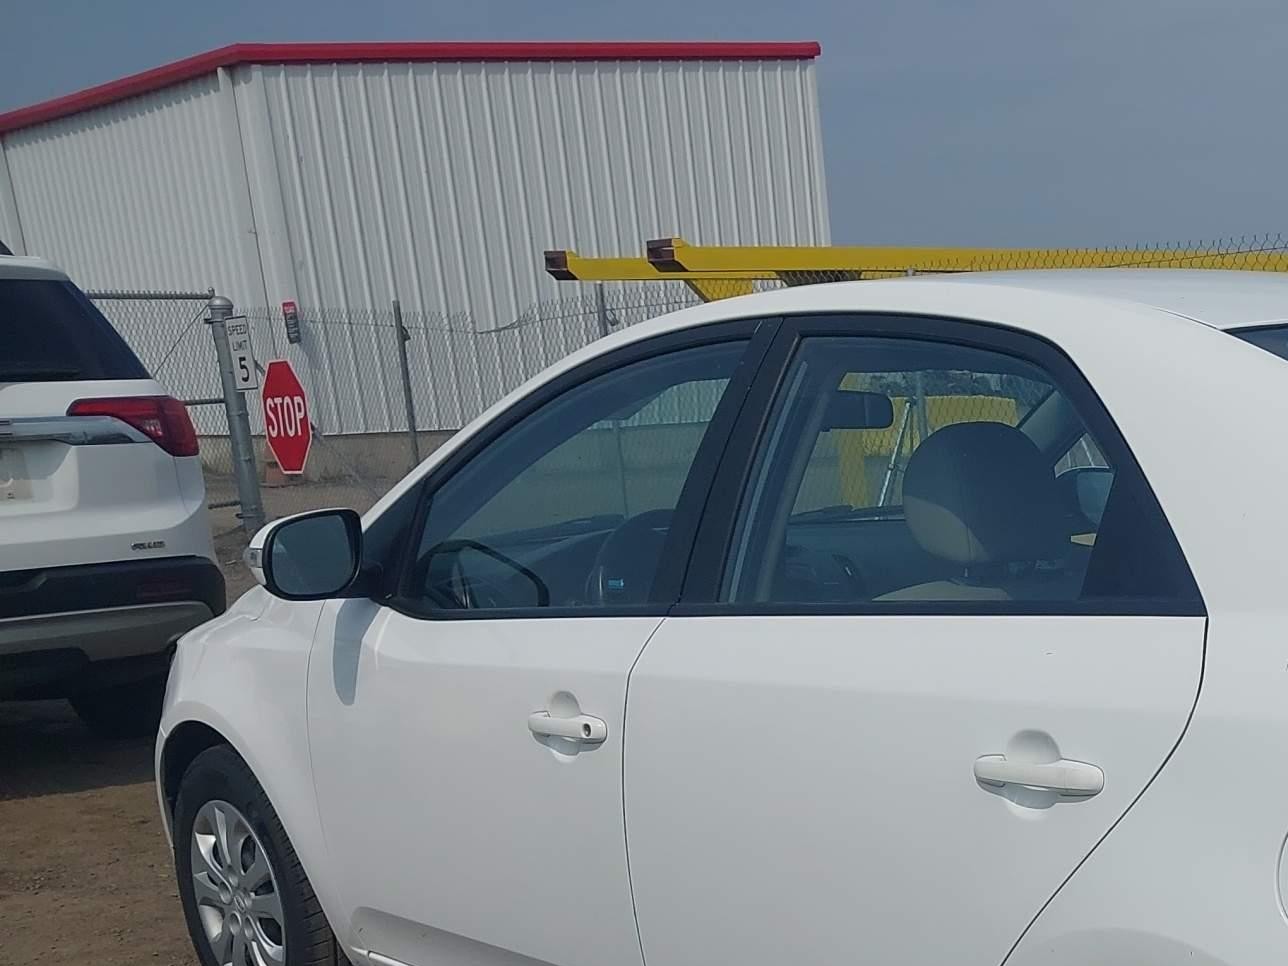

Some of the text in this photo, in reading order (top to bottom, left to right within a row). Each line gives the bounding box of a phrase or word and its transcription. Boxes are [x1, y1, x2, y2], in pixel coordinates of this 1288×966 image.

[228, 324, 247, 336] SPEED
[232, 340, 247, 351] LIMIT
[238, 356, 249, 382] 5
[266, 396, 305, 438] STOP
